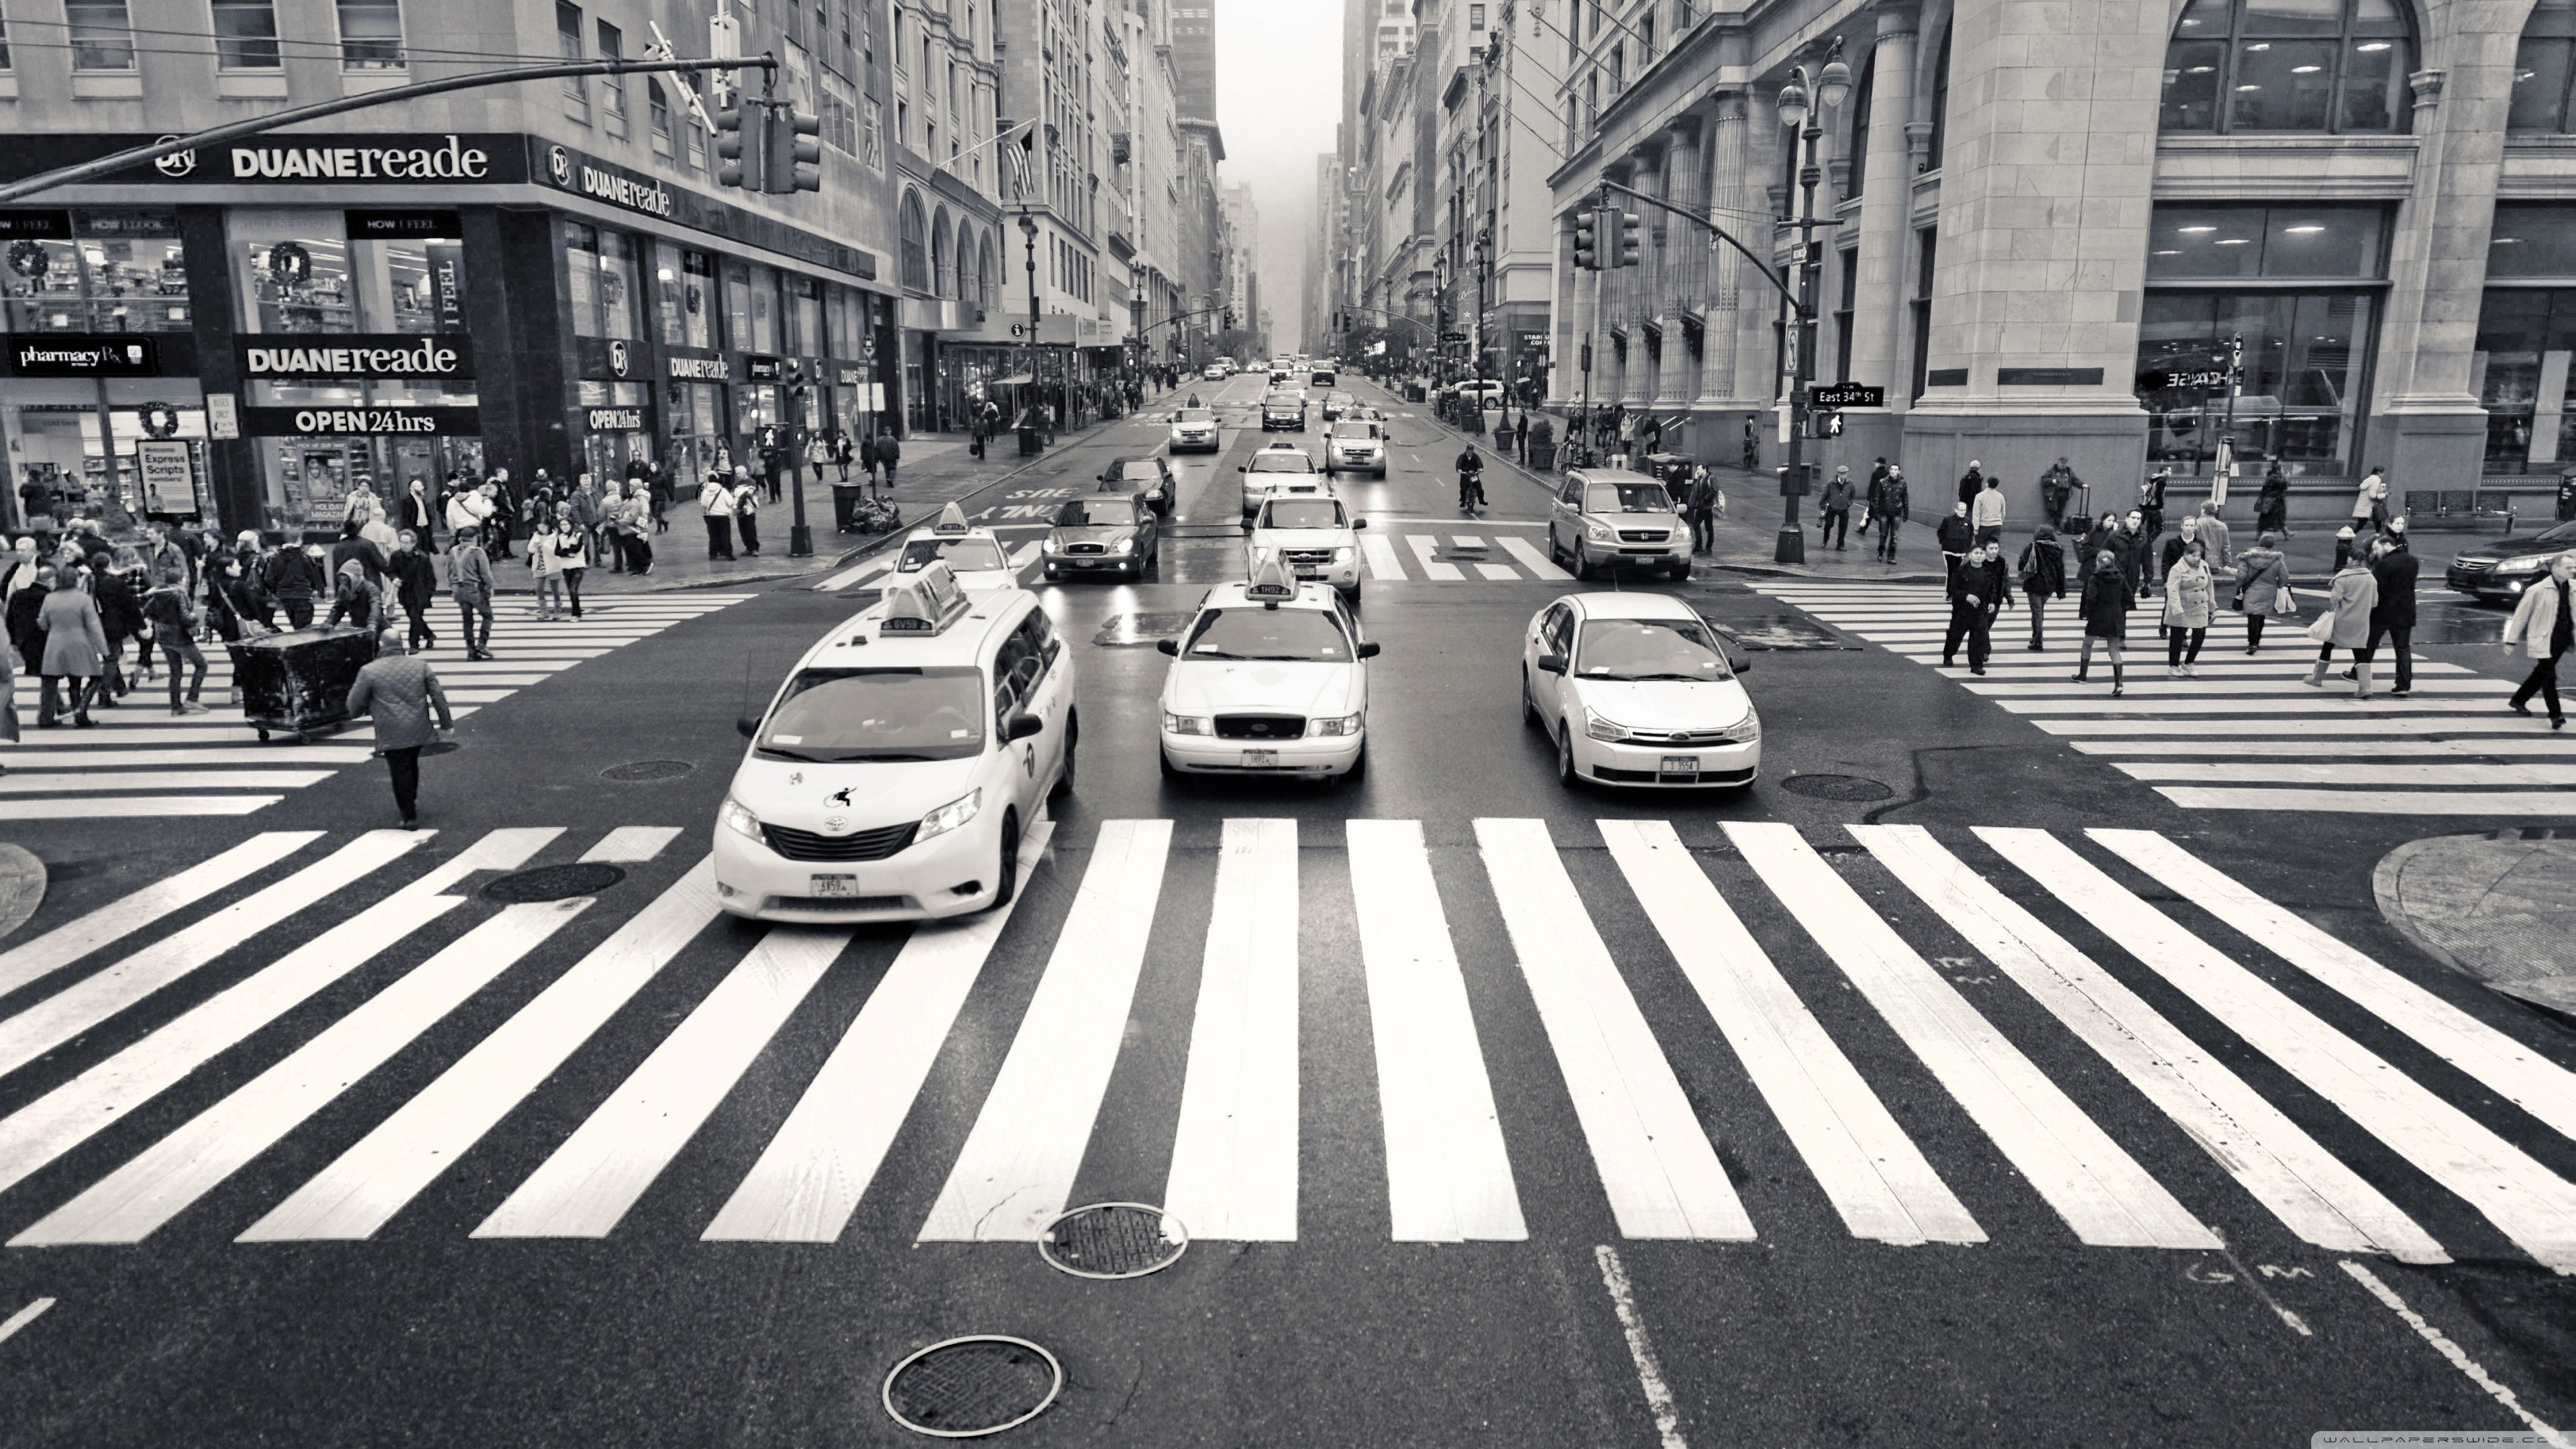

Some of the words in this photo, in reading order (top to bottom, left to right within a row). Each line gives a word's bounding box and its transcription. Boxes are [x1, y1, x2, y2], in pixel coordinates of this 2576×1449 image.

[367, 219, 395, 229] HOW
[20, 345, 100, 367] pharmacy
[1819, 391, 1841, 402] East
[1843, 391, 1862, 402] 34th
[1864, 391, 1875, 402] St
[145, 454, 185, 464] Express
[146, 465, 184, 475] Scripts
[1261, 586, 1279, 594] 1H92
[894, 619, 917, 629] 6V59
